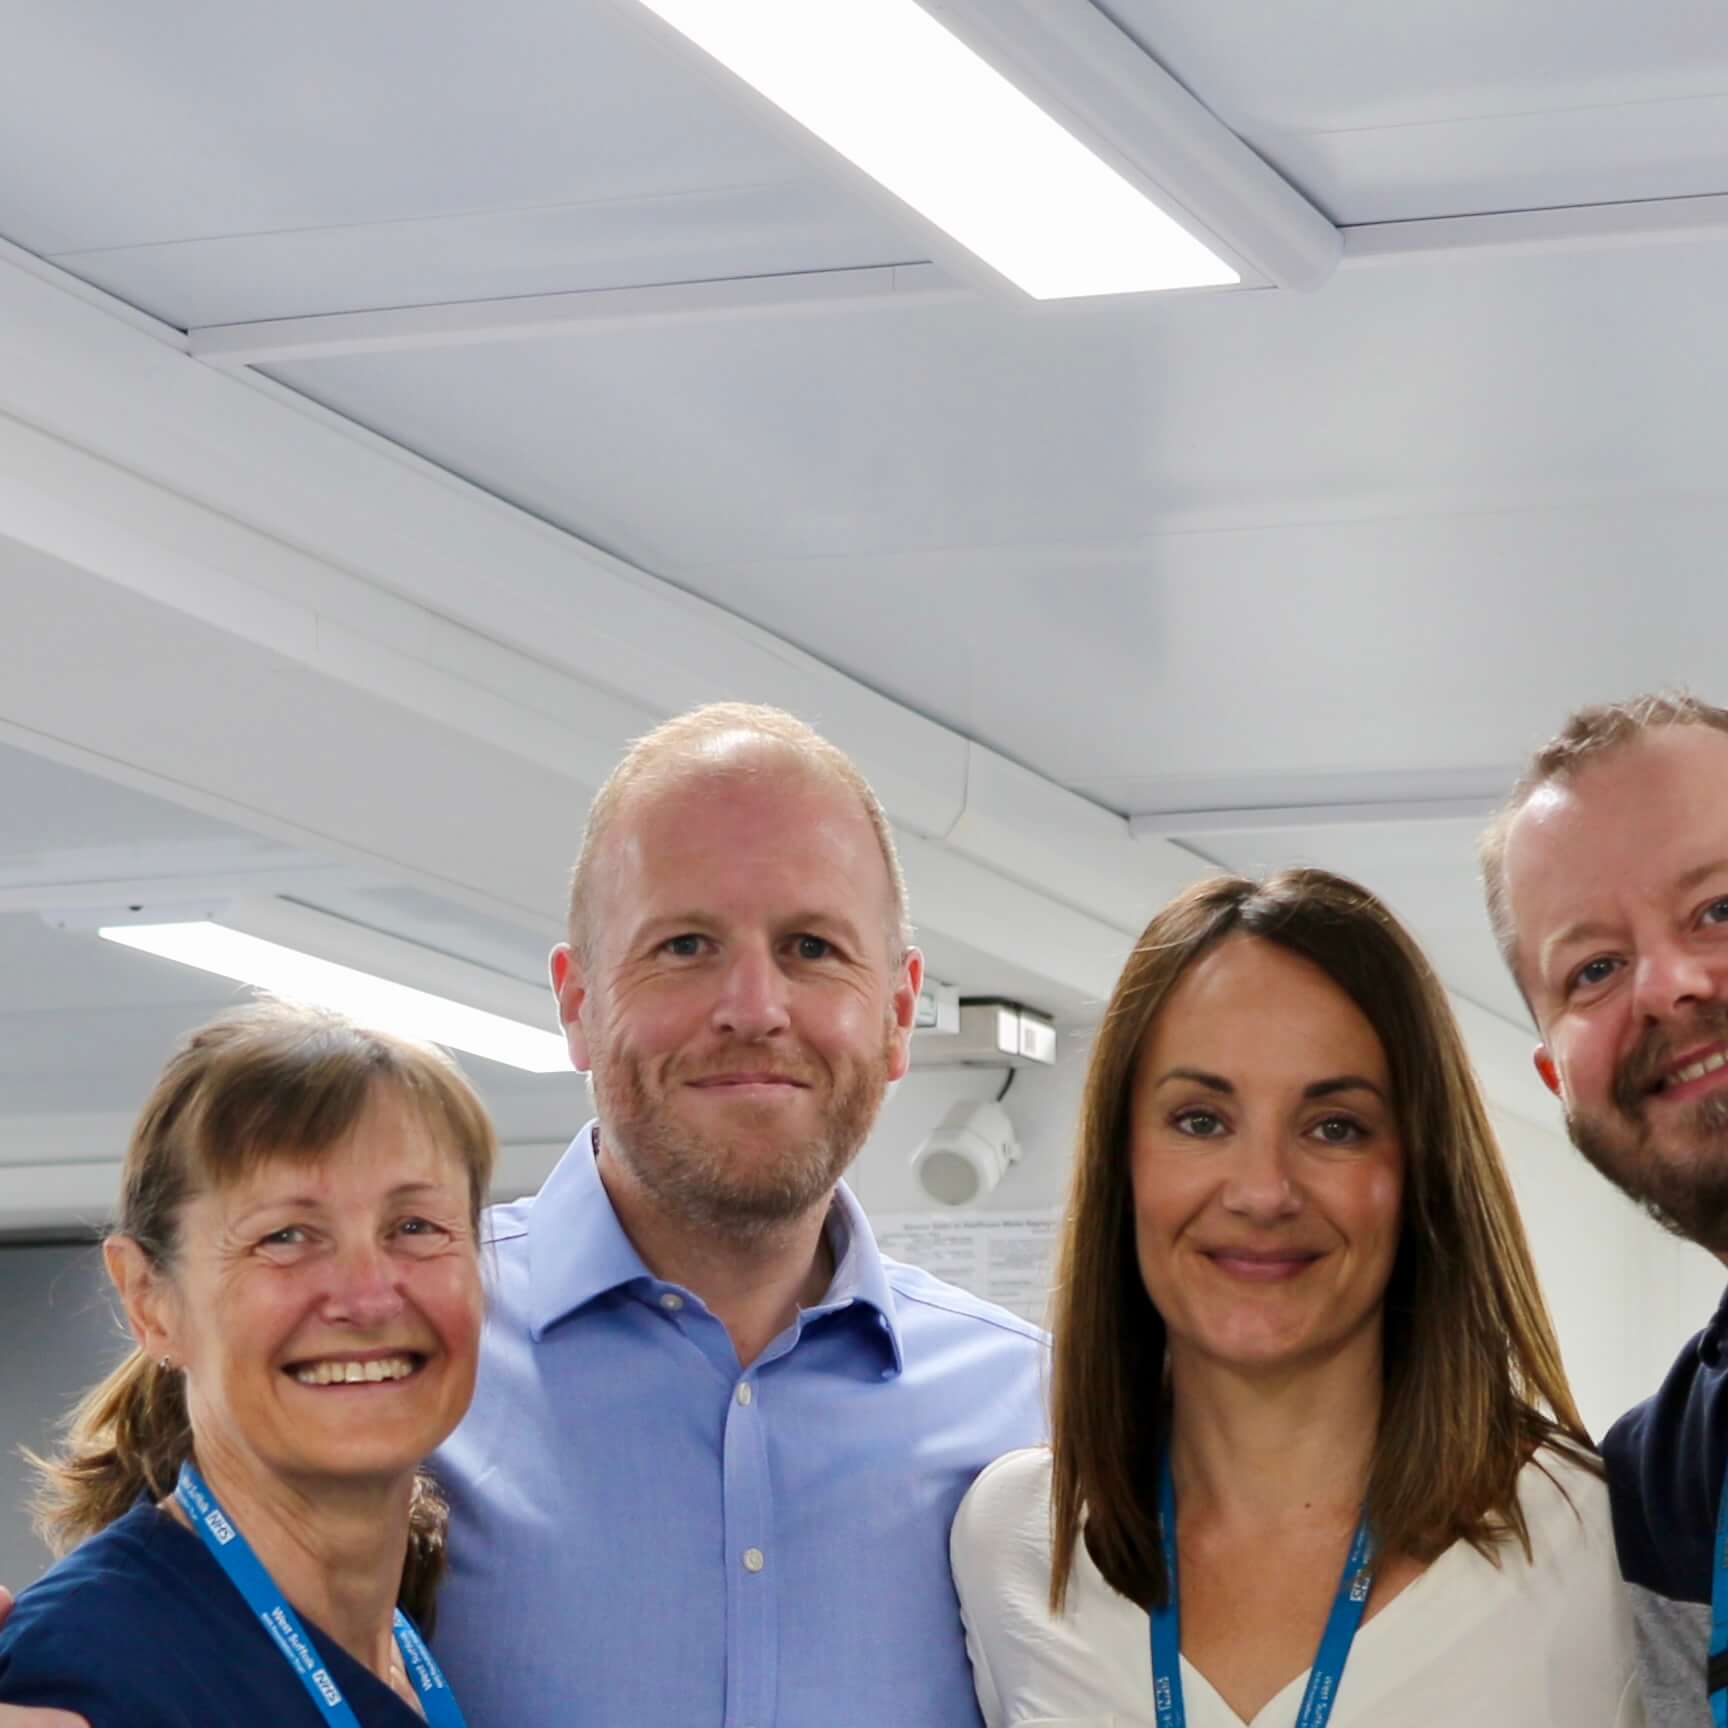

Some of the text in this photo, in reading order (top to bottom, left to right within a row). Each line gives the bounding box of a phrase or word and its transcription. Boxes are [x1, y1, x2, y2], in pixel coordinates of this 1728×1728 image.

[206, 1511, 235, 1544] NHS
[272, 1606, 341, 1706] West Suffolk NHS
